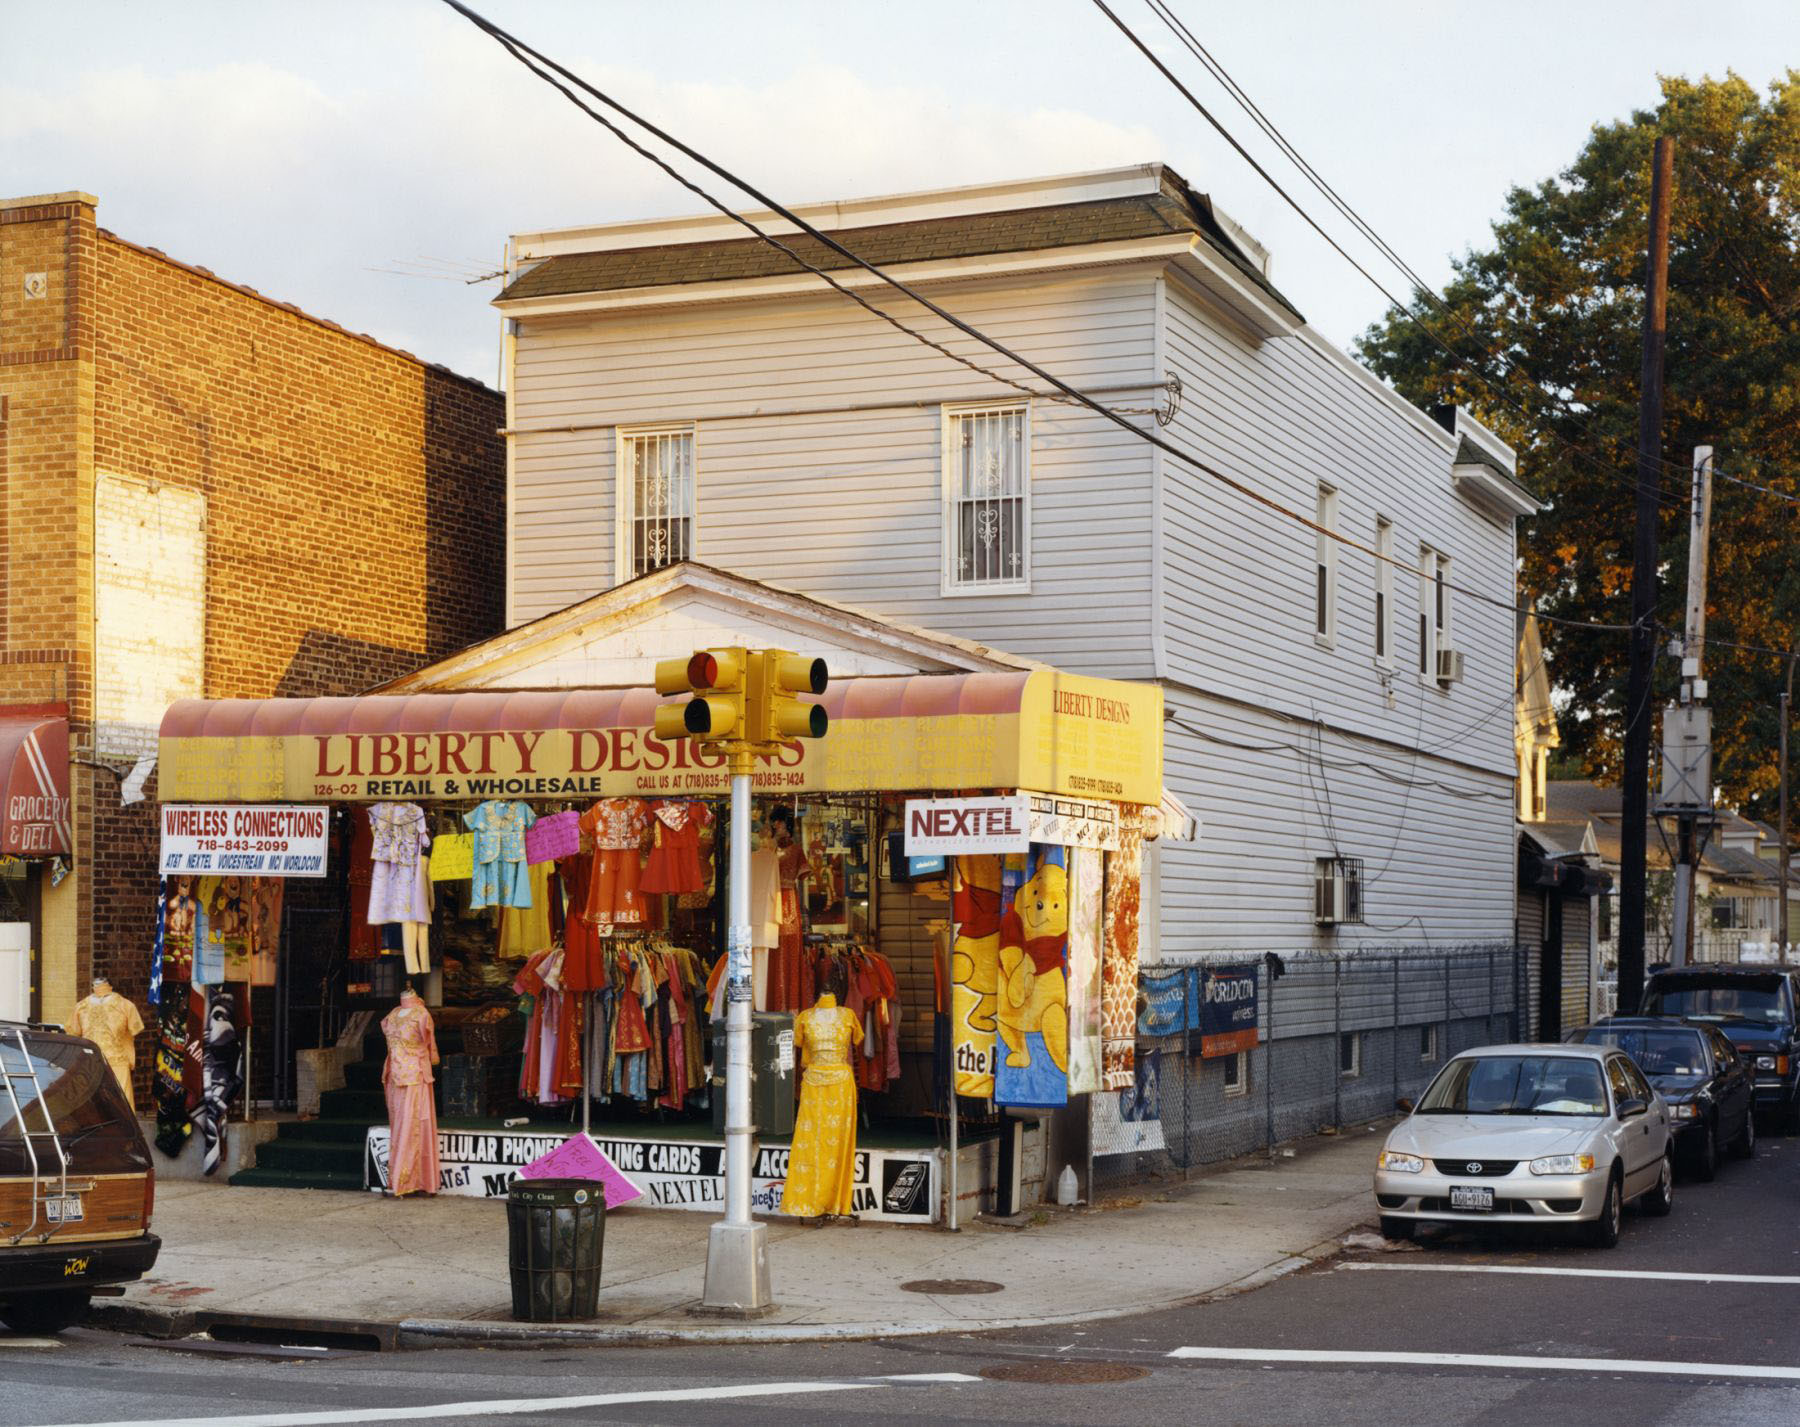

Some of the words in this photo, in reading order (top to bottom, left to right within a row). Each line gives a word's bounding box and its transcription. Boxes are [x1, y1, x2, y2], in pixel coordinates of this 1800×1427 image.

[1053, 690, 1093, 718] LIBERTY
[1096, 697, 1130, 724] DESIGNS
[314, 731, 545, 777] LIBERTY
[314, 784, 358, 796] 126-02
[367, 780, 435, 796] RETAIL
[444, 779, 459, 795] &
[467, 777, 601, 794] WHOLESALE
[637, 776, 656, 790] CALL
[659, 776, 669, 789] US
[672, 776, 682, 789] AT
[10, 795, 70, 820] GROCERY
[166, 810, 228, 837] WIRELESS
[234, 811, 324, 838] CONNECTIONS
[912, 807, 1021, 837] NEXTEL
[10, 825, 20, 845] &
[21, 826, 54, 850] DELI
[197, 840, 289, 852] 718-843-2099
[165, 853, 183, 869] AT&T
[186, 854, 212, 869] NEXTEL
[217, 854, 265, 870] VOICESTREAM
[268, 855, 282, 870] MCI
[283, 856, 322, 871] WORLDCOM
[957, 1043, 986, 1073] the
[439, 1134, 497, 1162] ELLULAR
[649, 1145, 701, 1175] CARDS
[537, 1192, 555, 1201] Clean
[650, 1178, 725, 1205] NEXTEL
[64, 1256, 89, 1276] WOW
